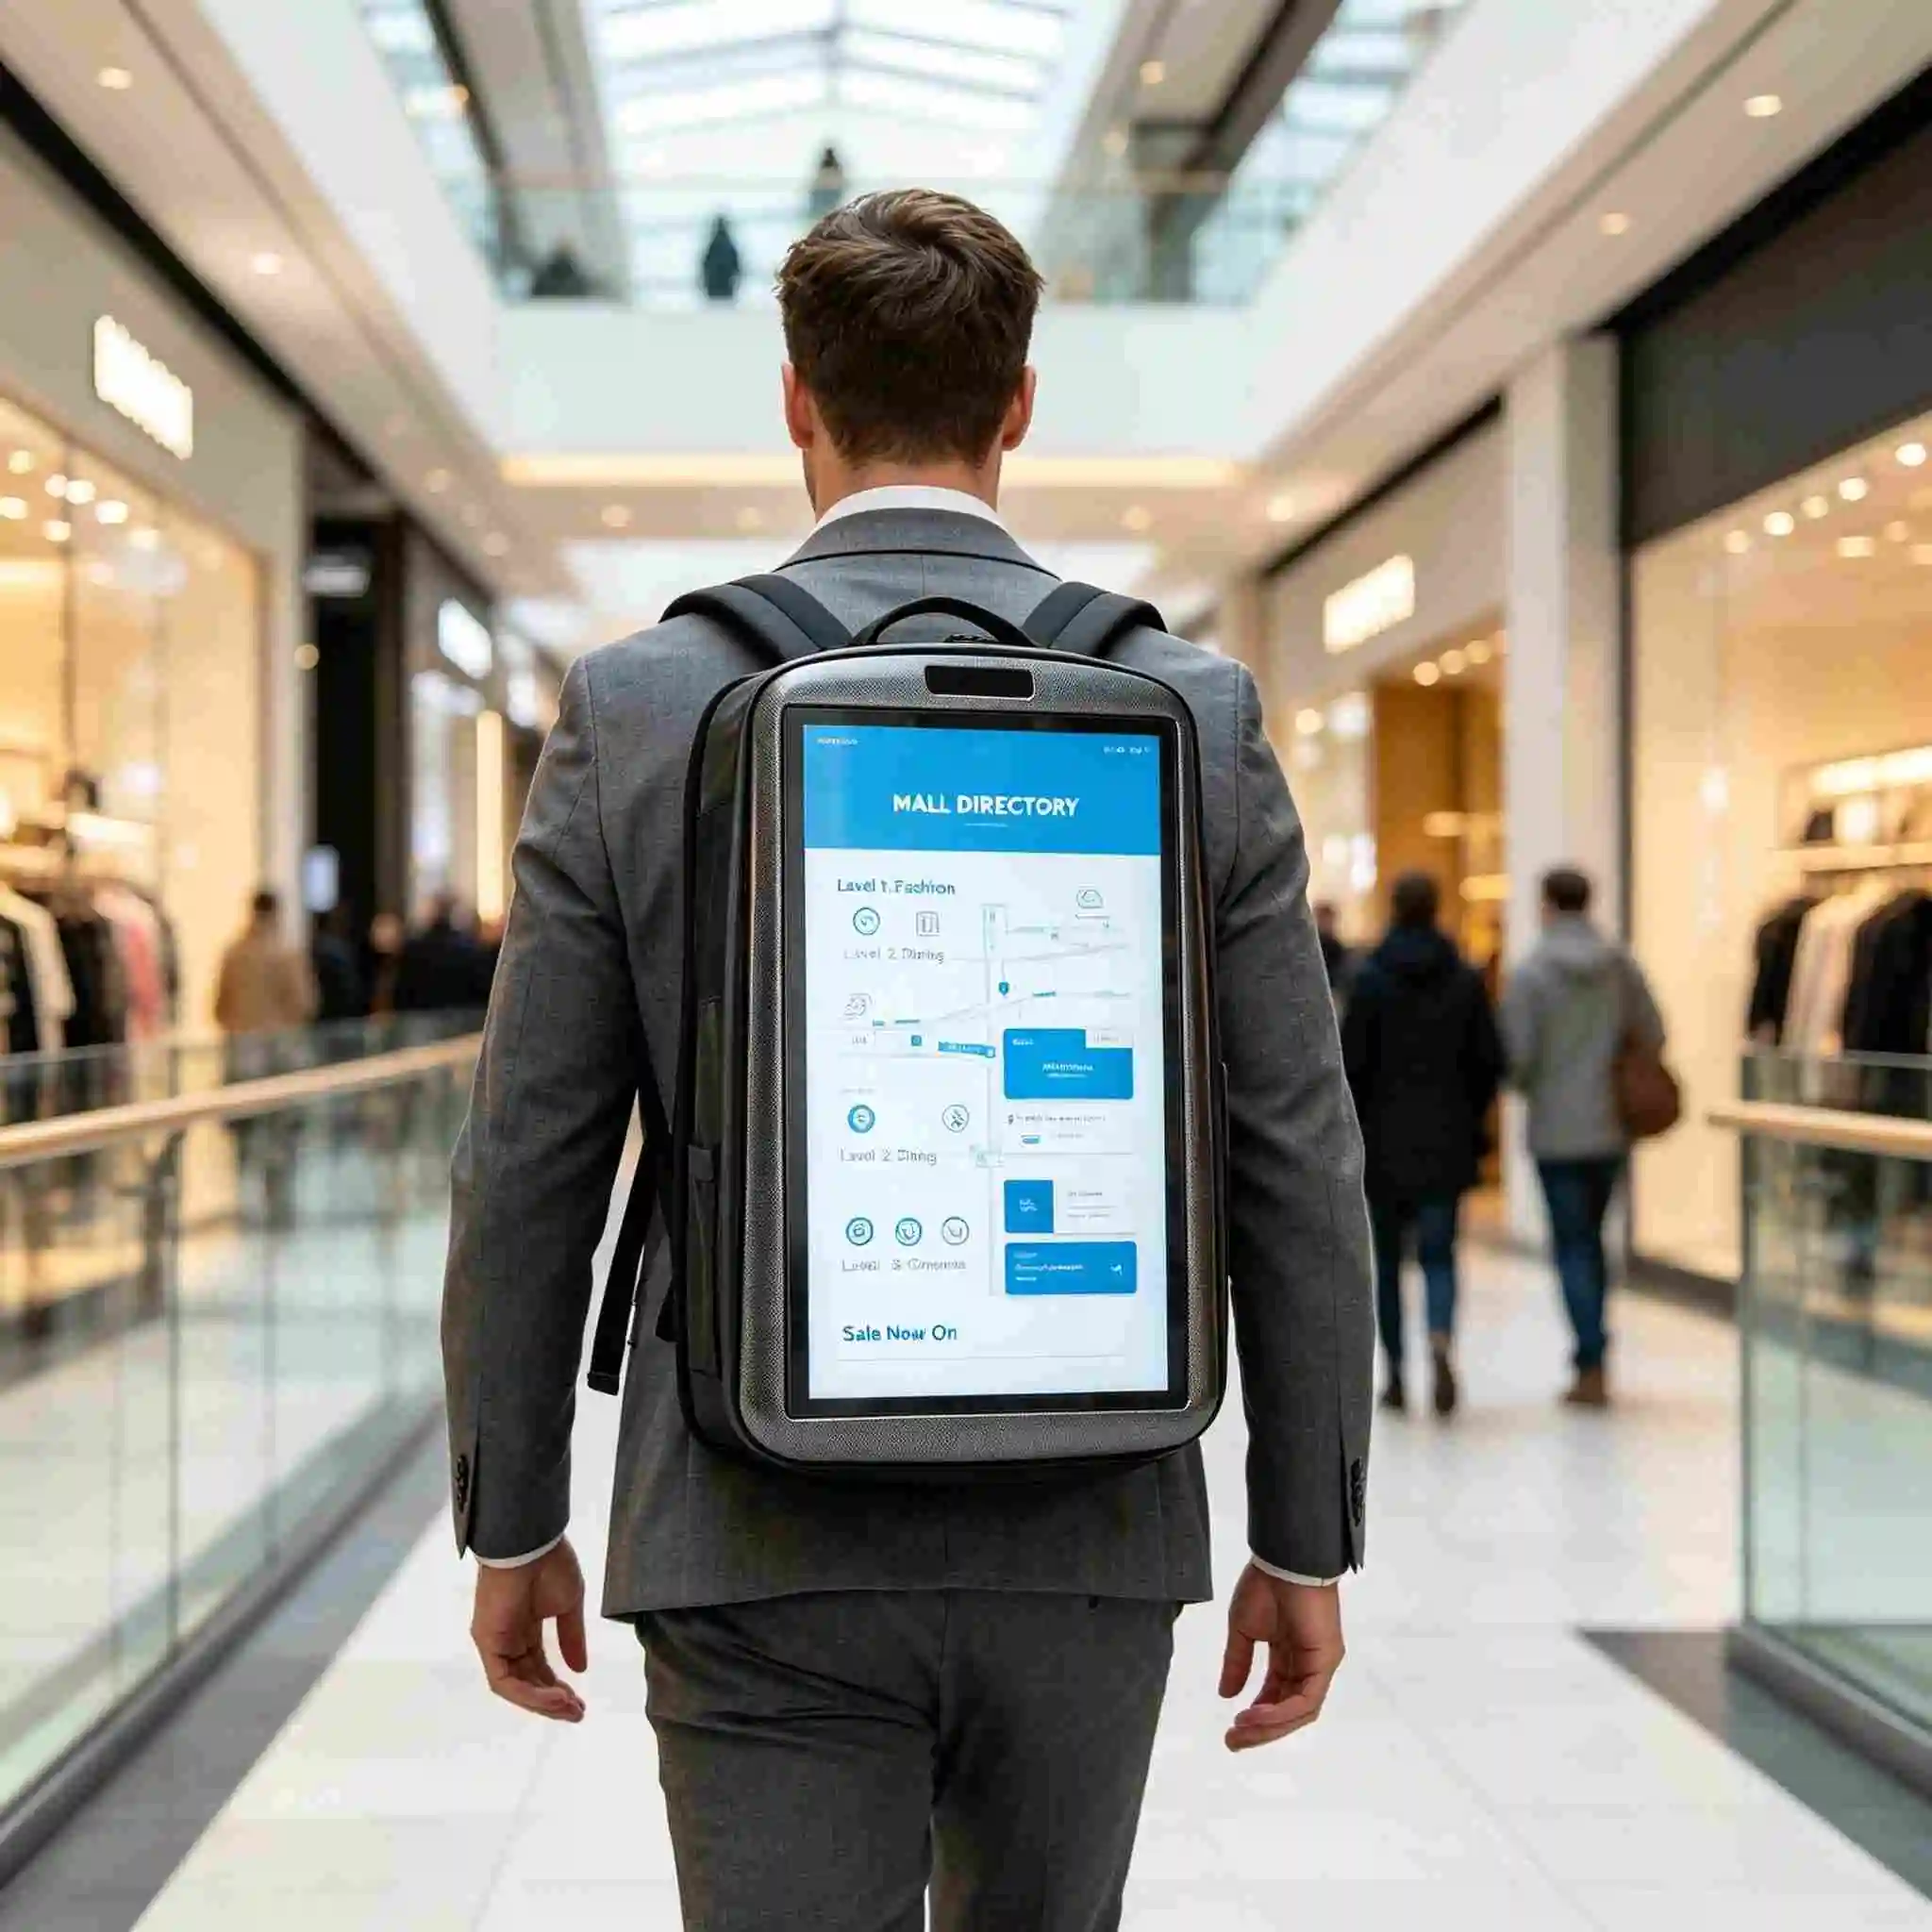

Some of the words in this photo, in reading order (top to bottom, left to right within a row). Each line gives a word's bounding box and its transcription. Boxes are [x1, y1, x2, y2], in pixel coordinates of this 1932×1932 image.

[893, 793, 952, 814] MALL
[957, 794, 1079, 817] DIRECTORY
[842, 1324, 881, 1341] Sale
[932, 1324, 958, 1341] On
